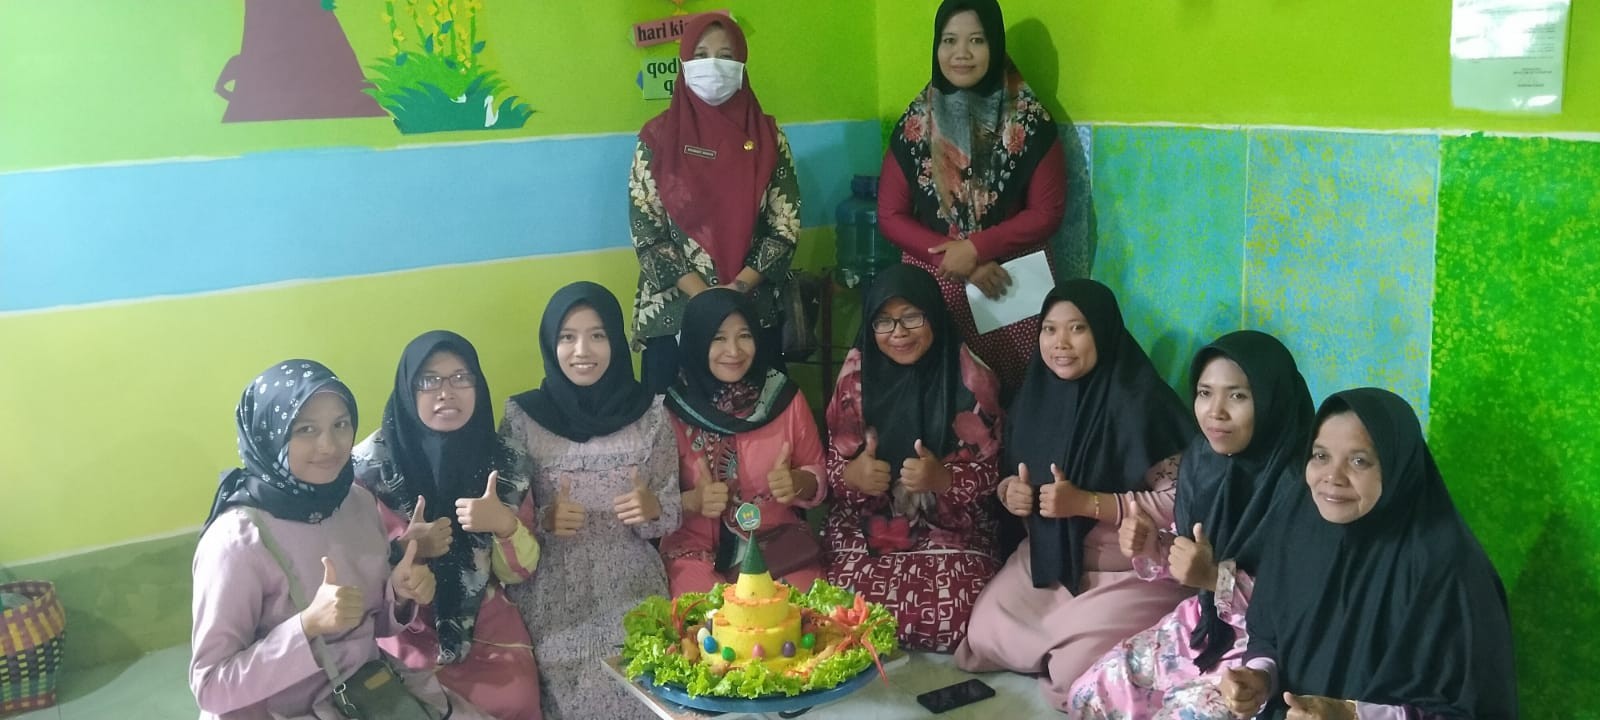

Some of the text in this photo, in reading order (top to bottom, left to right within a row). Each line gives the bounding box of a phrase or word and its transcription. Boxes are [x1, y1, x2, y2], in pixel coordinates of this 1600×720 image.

[637, 19, 688, 42] hari ki
[646, 58, 680, 78] qod
